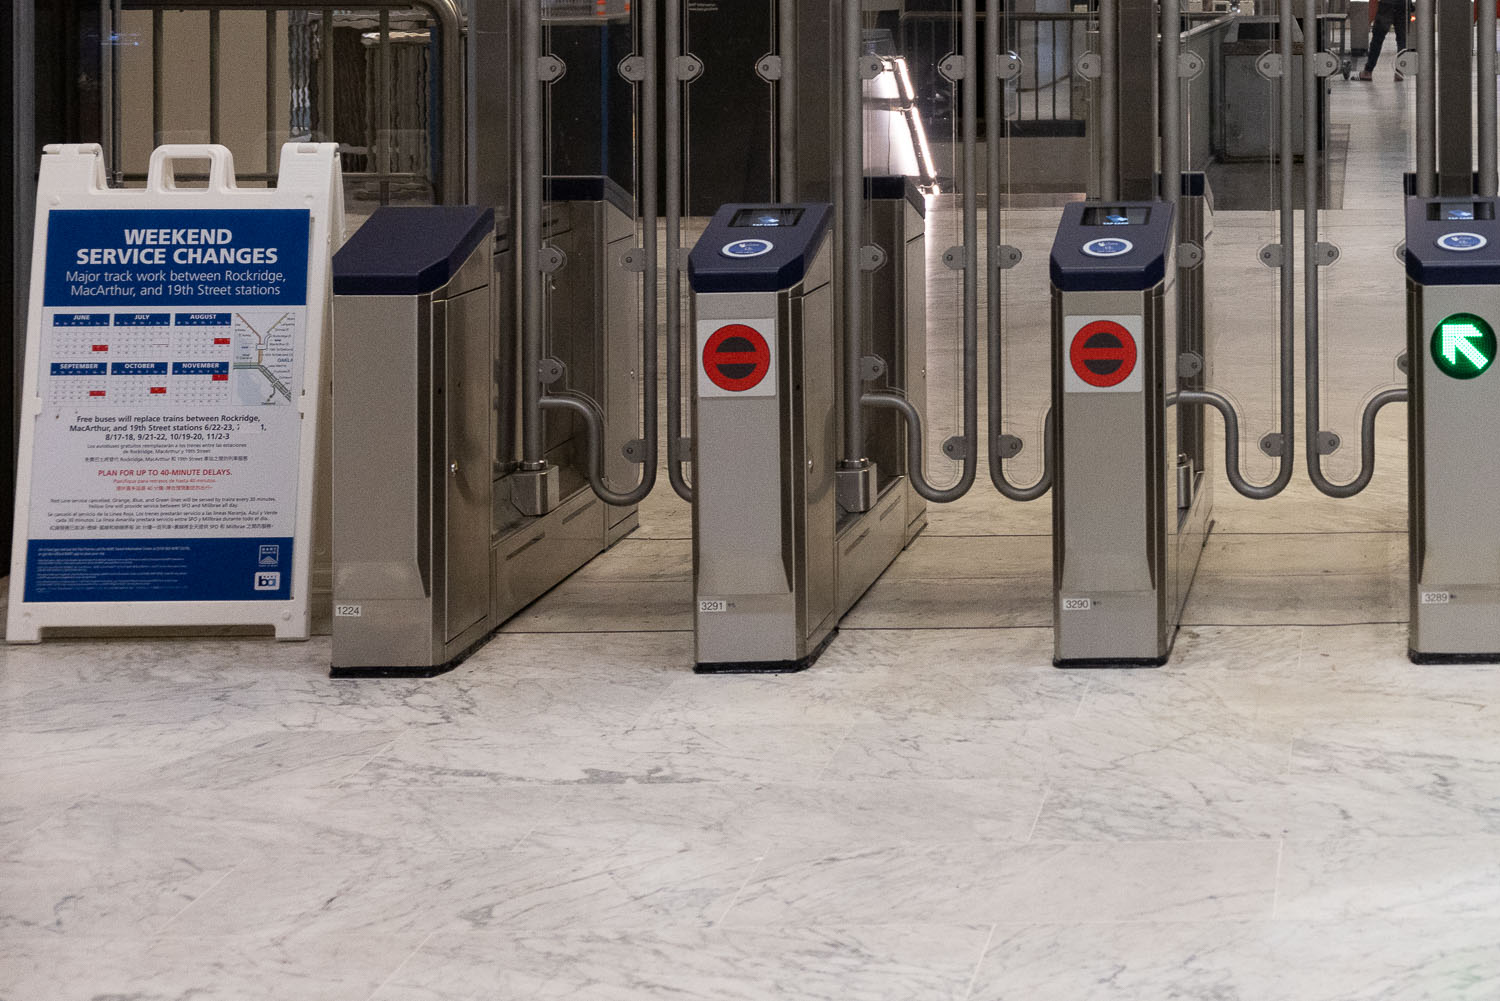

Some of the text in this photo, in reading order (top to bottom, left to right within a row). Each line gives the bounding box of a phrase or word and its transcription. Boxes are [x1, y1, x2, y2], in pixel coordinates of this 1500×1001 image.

[124, 229, 232, 245] WEEKEND
[76, 248, 278, 265] SERVICE CHANGES
[66, 270, 286, 284] Major track work between Rockridge,
[71, 284, 280, 297] MacArthur, and 19th Street stations
[134, 416, 160, 424] replace
[186, 414, 219, 422] between
[221, 414, 261, 423] Rockridge,
[701, 601, 723, 611] 3291
[1066, 599, 1089, 609] 3290
[337, 606, 360, 616] 1224
